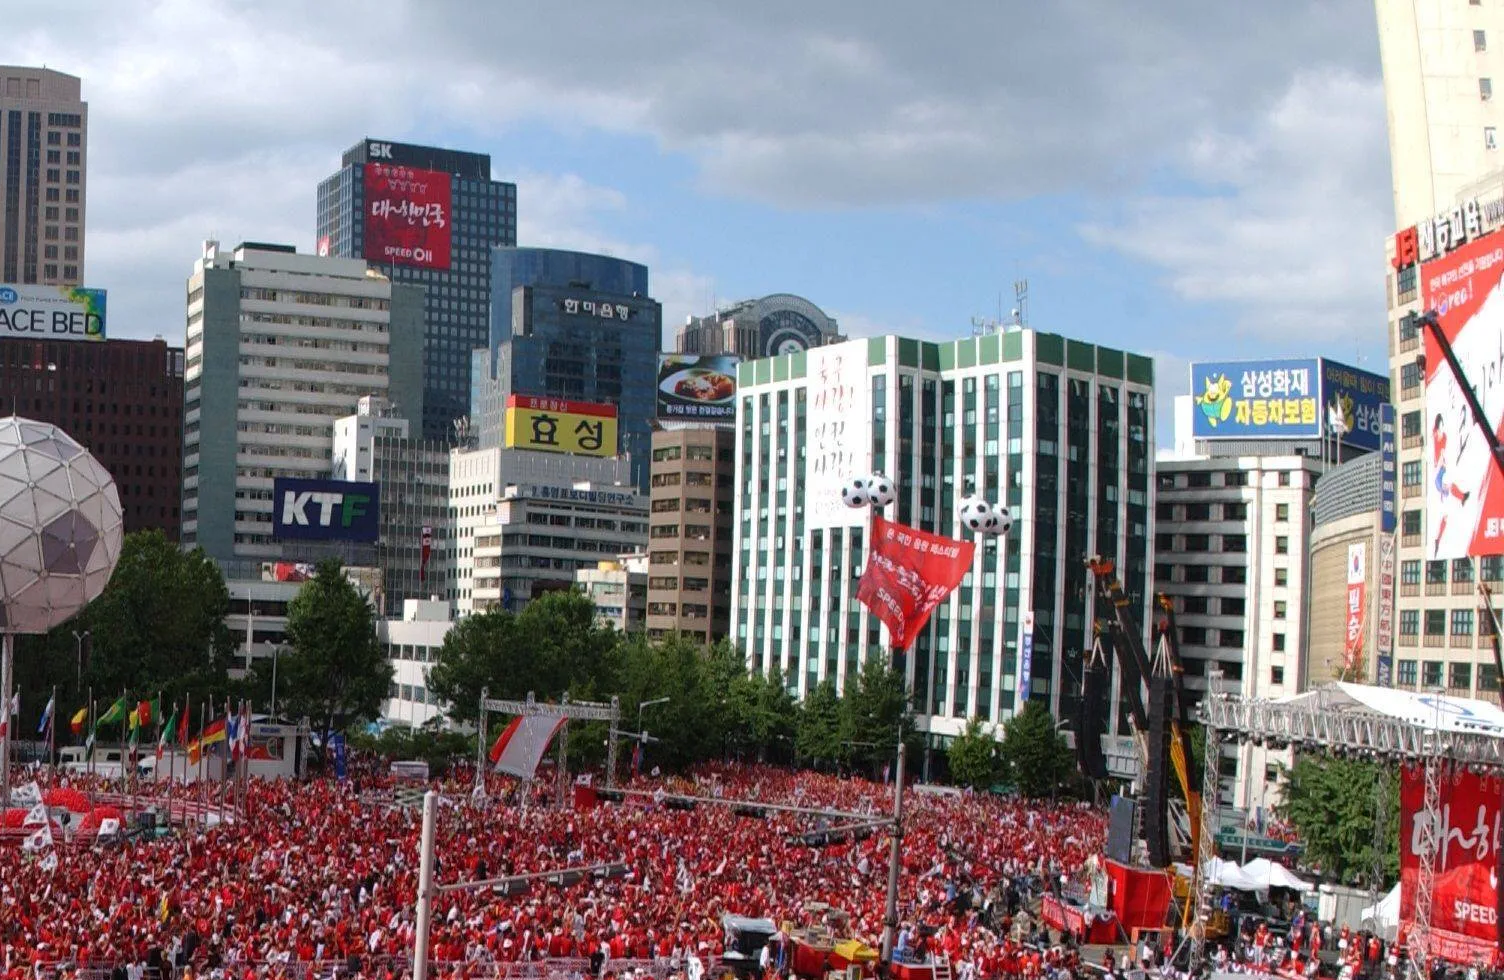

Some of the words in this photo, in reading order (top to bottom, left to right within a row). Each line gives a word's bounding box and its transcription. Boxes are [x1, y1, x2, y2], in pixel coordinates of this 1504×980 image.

[369, 143, 392, 159] SK
[384, 246, 412, 258] SPEED
[1391, 226, 1418, 269] JEI
[565, 299, 628, 320] 한미은행
[52, 311, 103, 335] BED
[1241, 368, 1309, 398] 삼성화재
[1235, 398, 1316, 426] 자동차보험
[530, 414, 603, 450] 효성
[282, 490, 371, 528] KTF
[1454, 901, 1496, 925] SPEED
